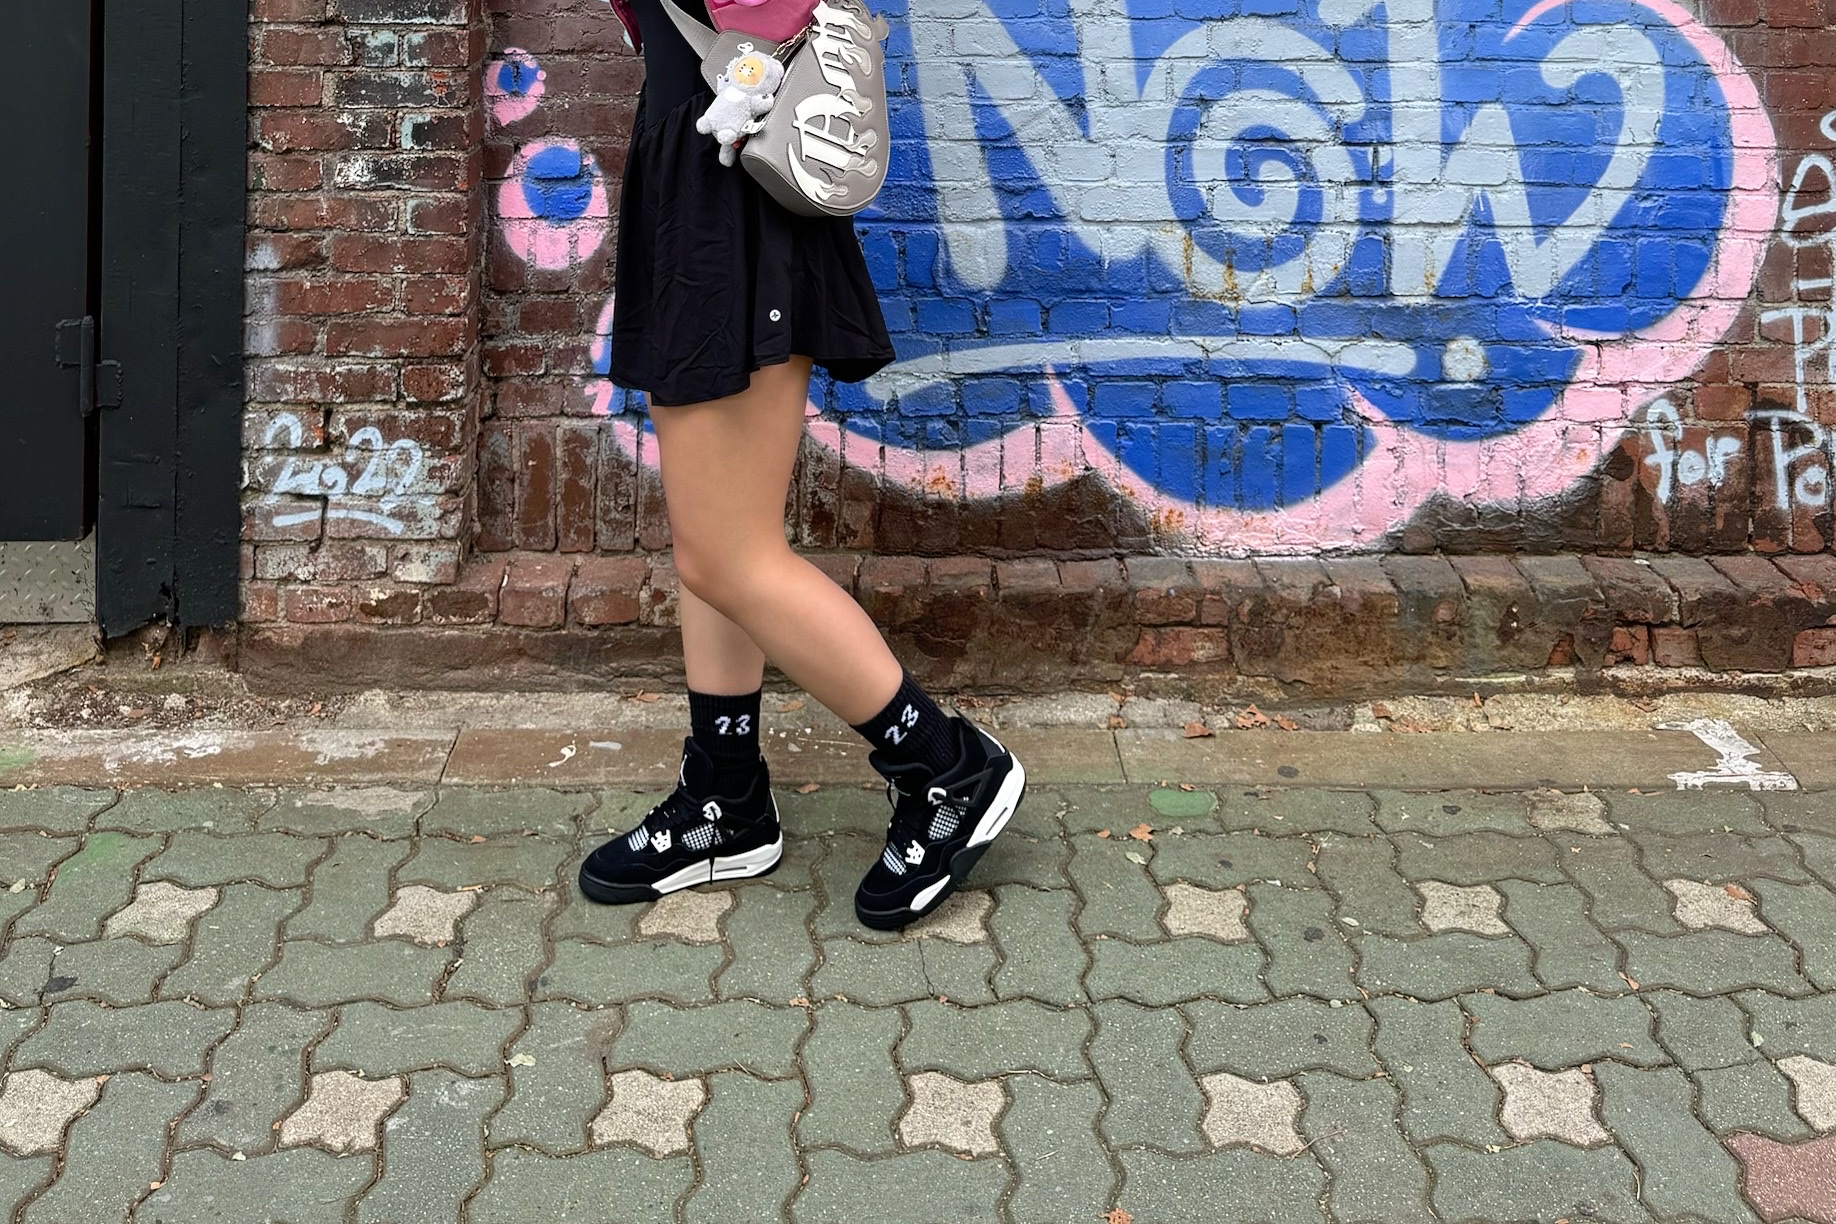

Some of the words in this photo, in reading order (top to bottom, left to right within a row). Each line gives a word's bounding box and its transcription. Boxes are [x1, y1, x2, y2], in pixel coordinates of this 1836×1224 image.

[1644, 398, 1742, 505] for
[715, 714, 751, 736] 23
[885, 703, 920, 745] 23
